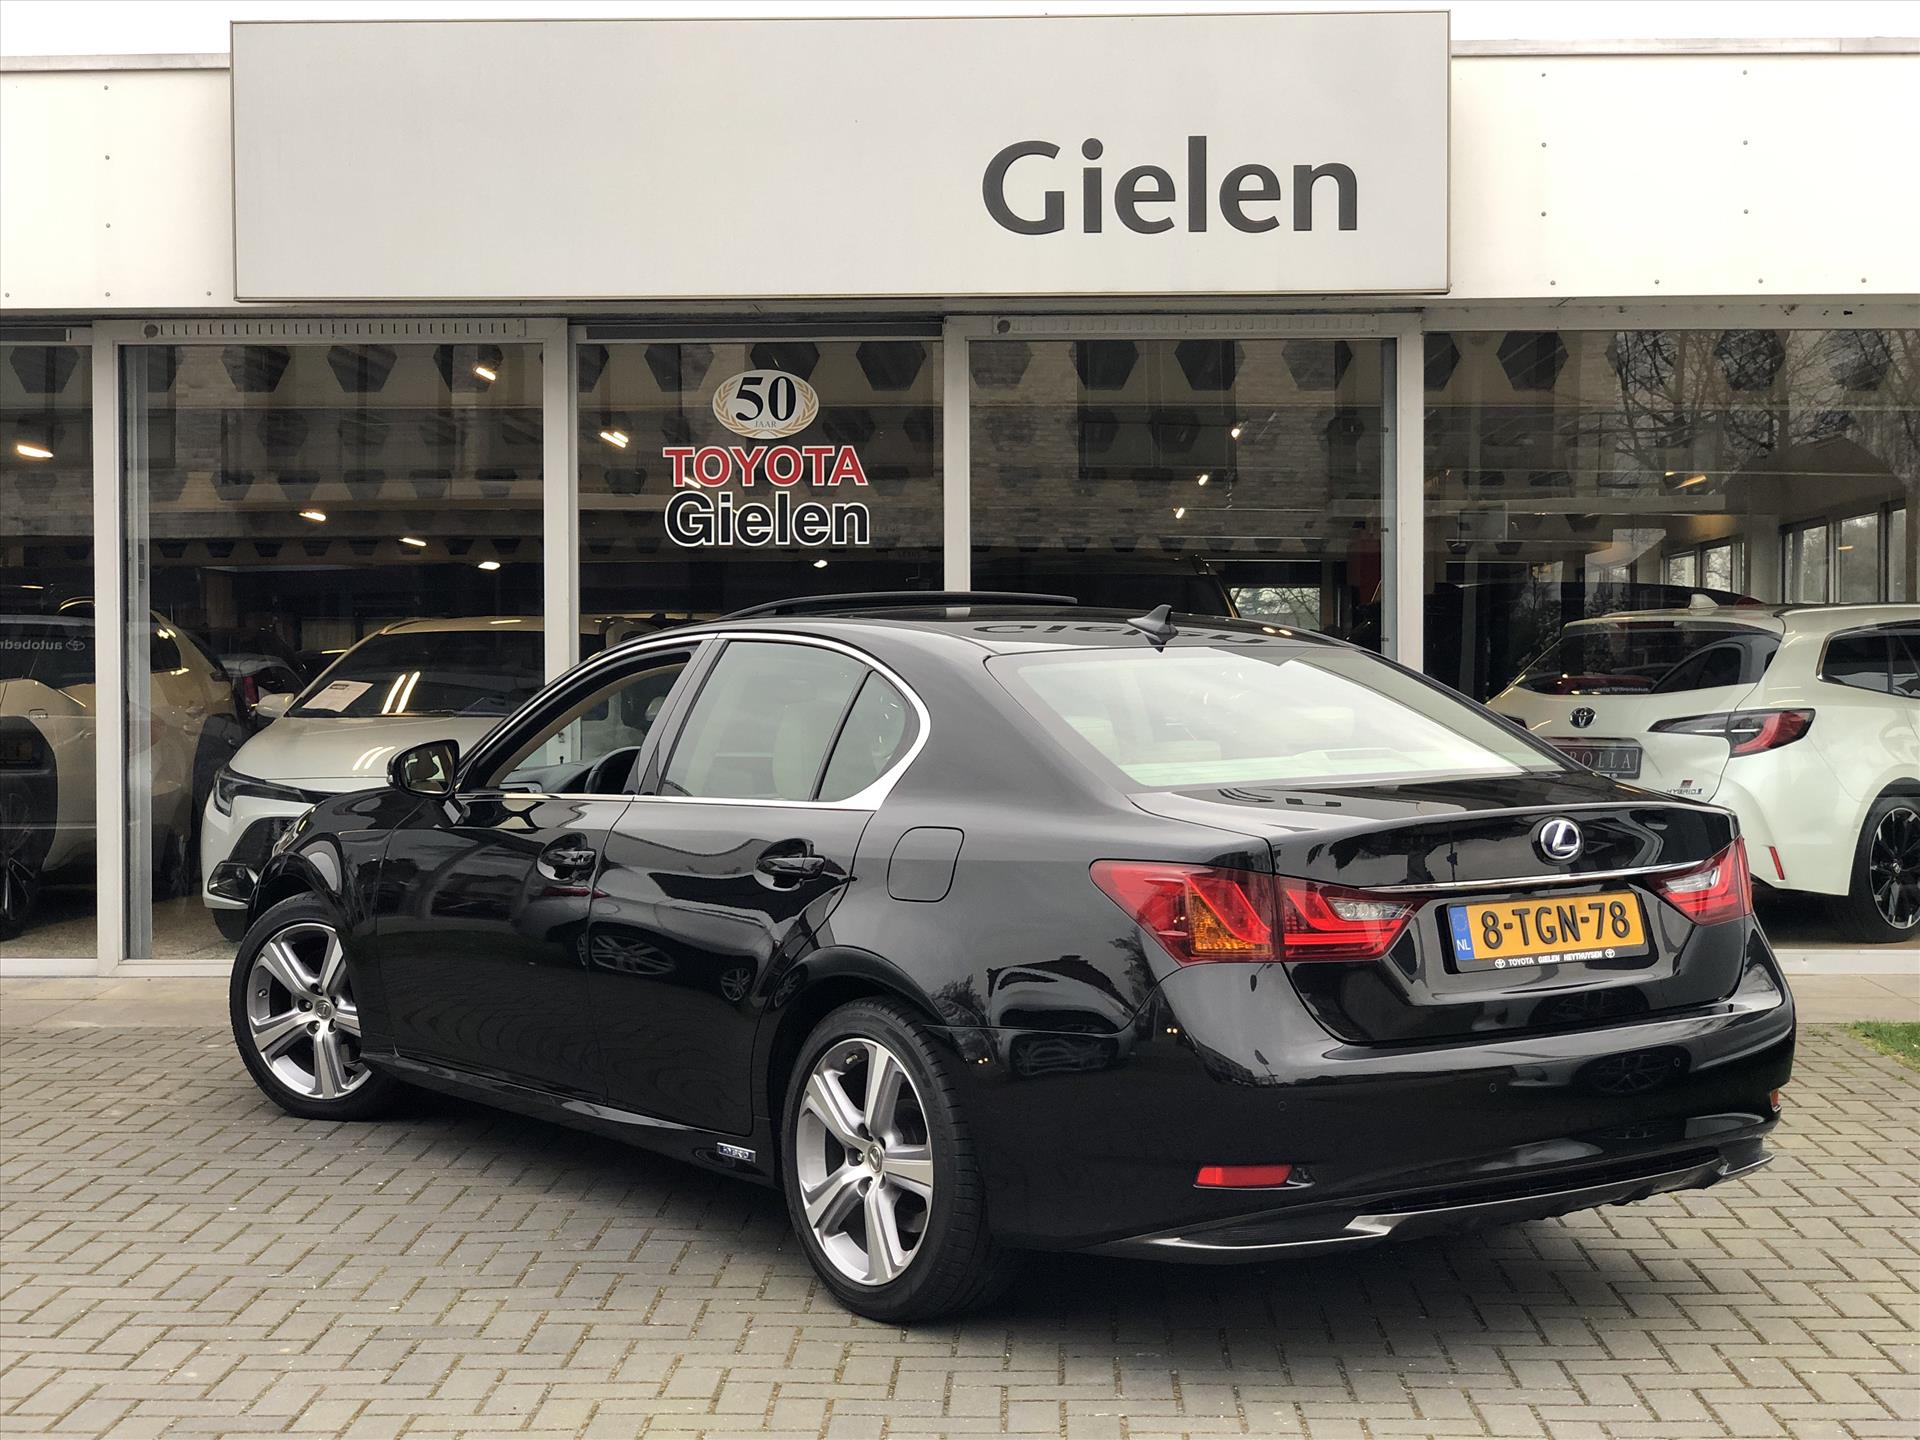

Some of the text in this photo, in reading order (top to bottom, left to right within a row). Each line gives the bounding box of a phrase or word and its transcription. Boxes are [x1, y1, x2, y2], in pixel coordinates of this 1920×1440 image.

[982, 135, 1358, 236] Gielen
[735, 376, 797, 421] 50
[755, 420, 777, 428] JAAR
[662, 445, 869, 487] TOYOTA
[664, 490, 871, 547] Gielen
[1456, 939, 1471, 951] NL
[1481, 901, 1631, 949] 8-TGN-78
[1508, 957, 1534, 966] TOYOTA
[1538, 954, 1560, 964] GIELEN
